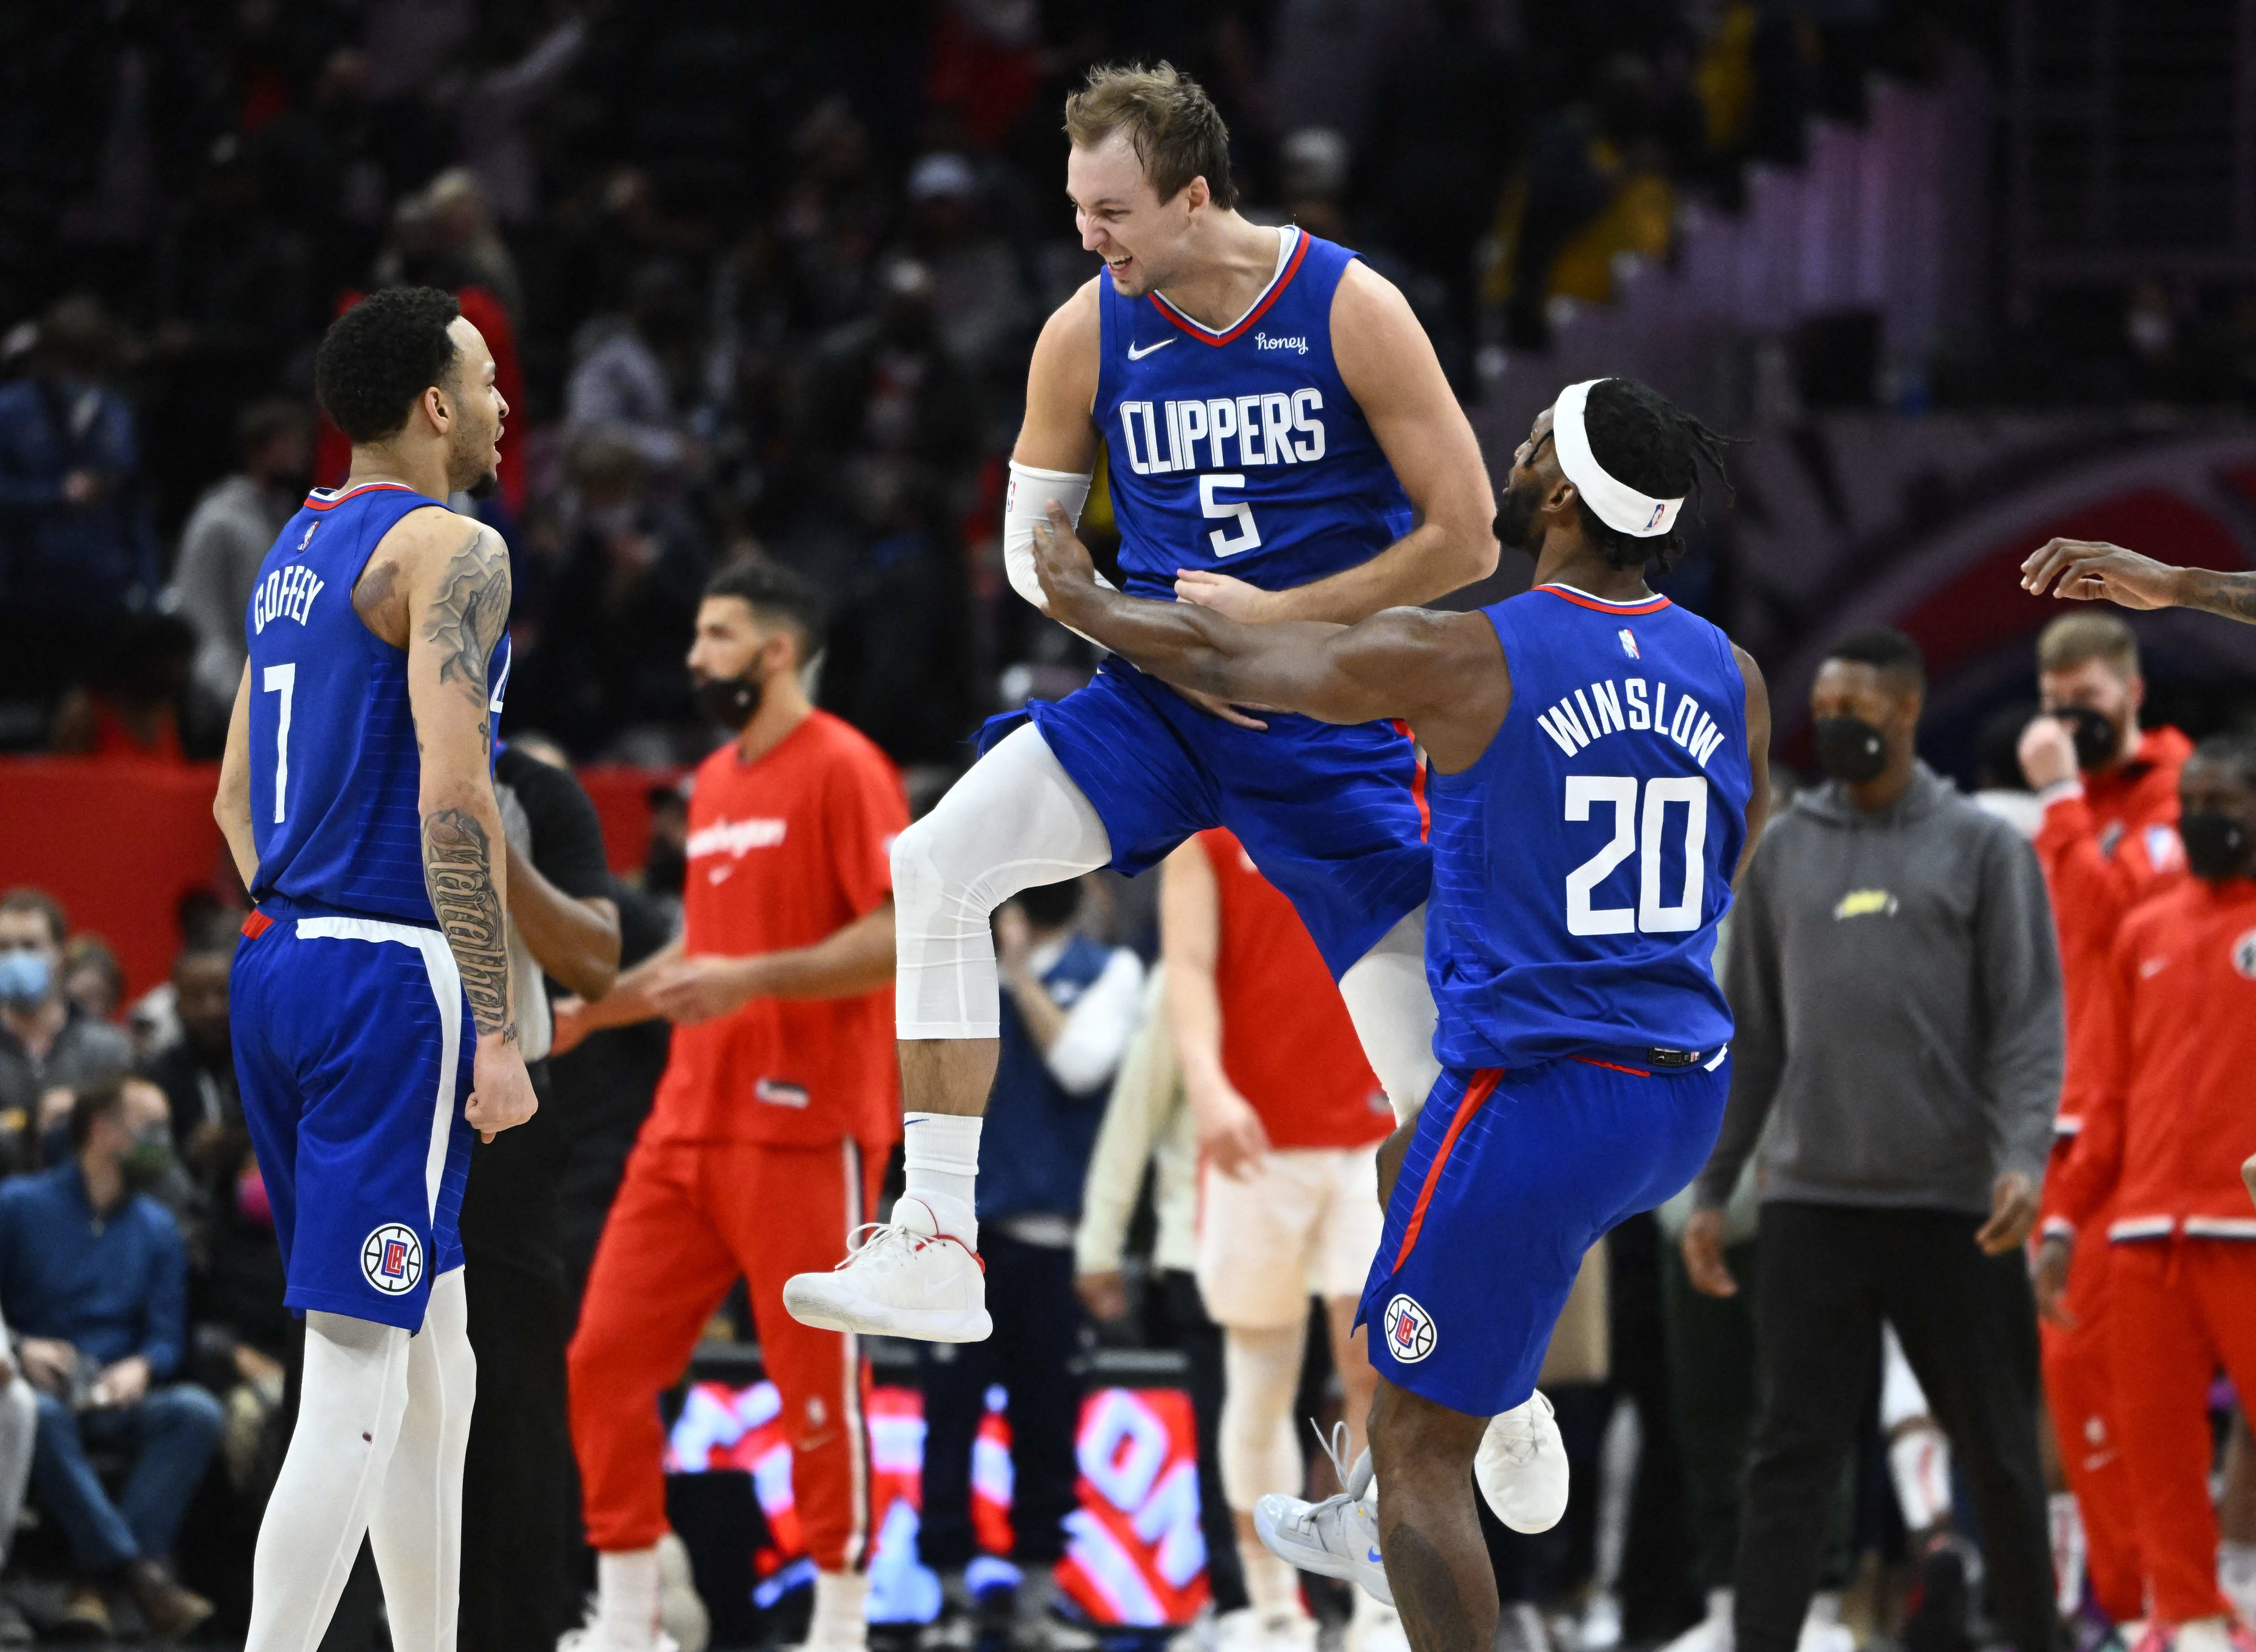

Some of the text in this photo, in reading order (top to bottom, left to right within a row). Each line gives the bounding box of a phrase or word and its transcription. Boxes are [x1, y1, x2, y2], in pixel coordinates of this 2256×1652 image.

[1255, 332, 1308, 355] honey
[1120, 387, 1325, 474] CLIPPERS
[1199, 474, 1261, 558] 5
[255, 565, 325, 635] COFFEY
[263, 663, 296, 823] 7
[1537, 678, 1725, 769] WINSLOW
[1565, 776, 1708, 936] 20
[428, 836, 506, 1028] Marathon
